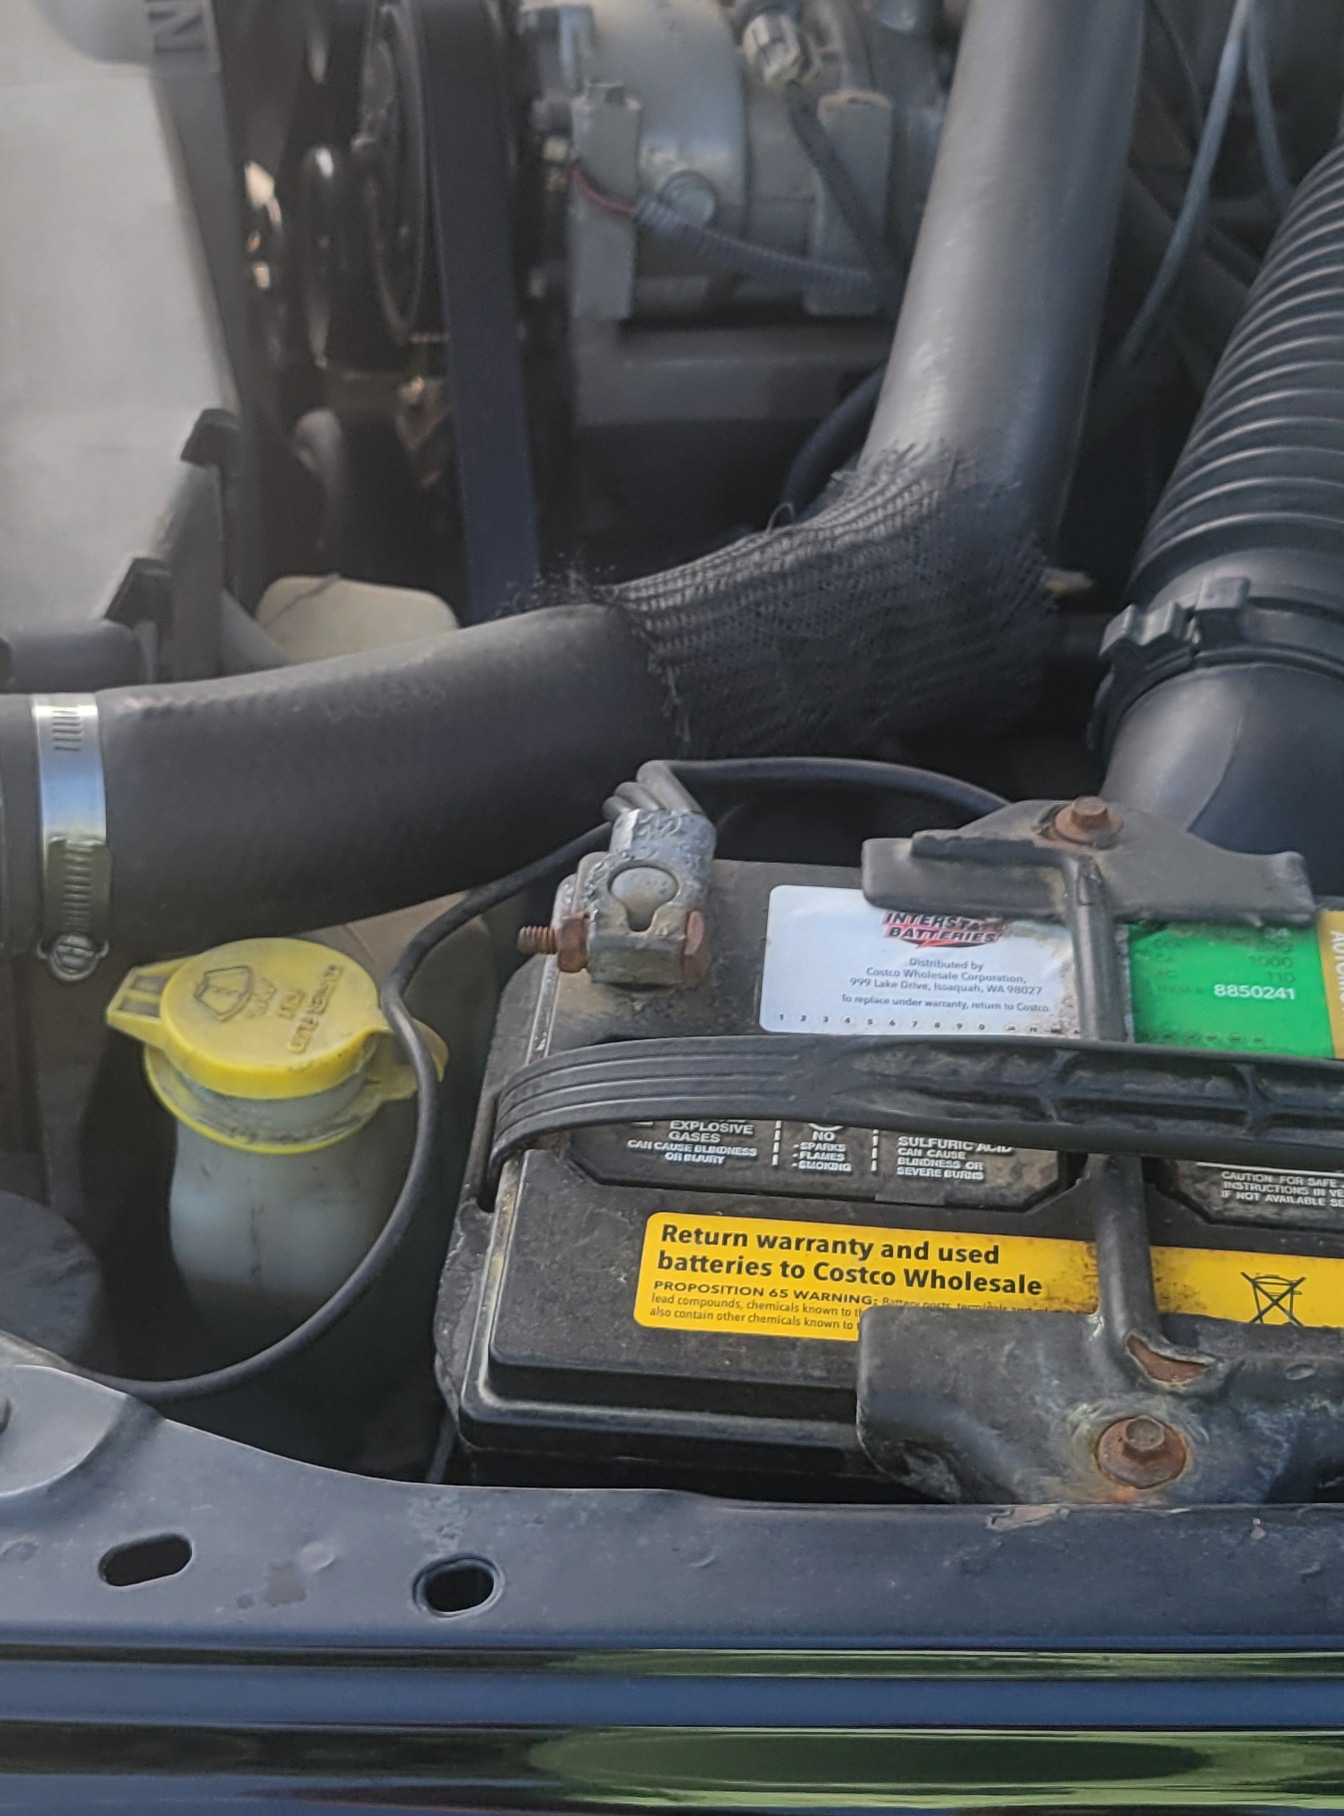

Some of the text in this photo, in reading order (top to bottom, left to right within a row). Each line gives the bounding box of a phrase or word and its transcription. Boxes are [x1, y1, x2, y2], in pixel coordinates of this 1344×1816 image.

[888, 927, 997, 942] BATTERIES
[909, 957, 984, 972] Distributed by
[866, 967, 1027, 985] Costco Wholesale Corporation,
[850, 977, 1043, 995] 999 Lake Drive, Issaquah, WA 98027
[1213, 983, 1296, 1001] 8850241
[842, 994, 852, 1003] To
[855, 996, 890, 1006] replace
[892, 997, 922, 1007] under
[924, 1001, 970, 1011] warranty,
[972, 1002, 1001, 1010] return
[1004, 1003, 1014, 1011] to
[669, 1121, 754, 1134] EXPLOSIVE
[668, 1131, 721, 1143] GASES
[812, 1131, 835, 1142] NO
[898, 1136, 973, 1151] SULFURIC
[627, 1139, 757, 1156] CAN CAUSE BLINDNESS
[898, 1148, 966, 1159] CAN CAUSE
[665, 1152, 683, 1162] OR
[898, 1157, 984, 1170] BLINDNESS OR
[897, 1166, 984, 1180] SEVERE BURNS
[1221, 1170, 1272, 1183] CAUTION
[1279, 1175, 1304, 1186] FOR
[1308, 1177, 1337, 1188] SAFE
[1224, 1181, 1308, 1196] INSTRUCTIONS
[1313, 1187, 1326, 1196] IN
[1221, 1190, 1230, 1199] IF
[1237, 1191, 1261, 1201] NOT
[1265, 1194, 1325, 1206] AVAILABLE
[661, 1223, 999, 1265] Return warranty and used
[657, 1250, 1042, 1295] batteries to Costco Wholesale
[653, 1280, 764, 1297] PROPOSITION
[768, 1288, 789, 1299] 65
[793, 1290, 878, 1305] WARNING:
[652, 1293, 674, 1304] lead
[677, 1296, 743, 1310] compounds,
[746, 1299, 800, 1313] chemicals
[802, 1304, 838, 1316] known
[841, 1308, 851, 1317] to
[650, 1307, 854, 1330] also contain other chemicals known to
